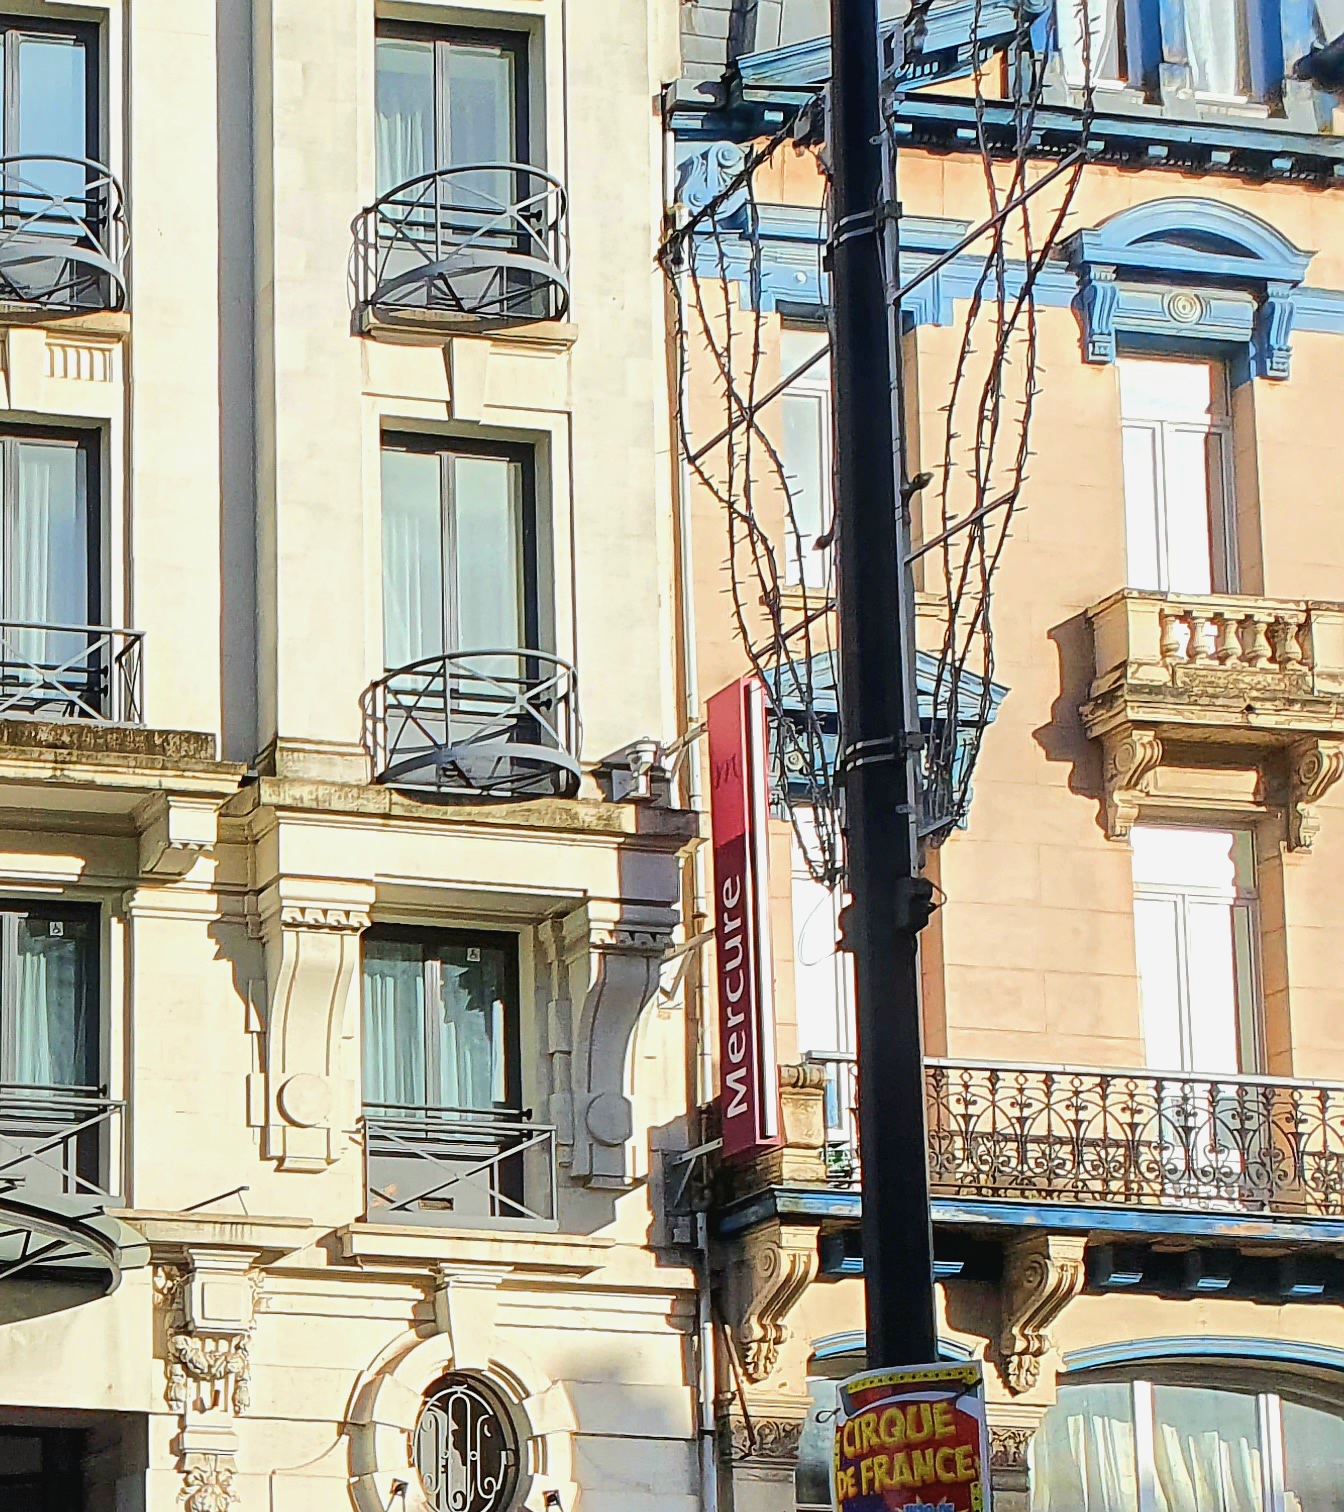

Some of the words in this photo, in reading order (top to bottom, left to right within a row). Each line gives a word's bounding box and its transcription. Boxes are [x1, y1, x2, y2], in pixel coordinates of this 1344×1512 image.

[722, 873, 749, 1119] Mercure
[842, 1401, 957, 1459] CIRQUE
[836, 1465, 858, 1501] DE
[860, 1444, 976, 1496] FRANCE
